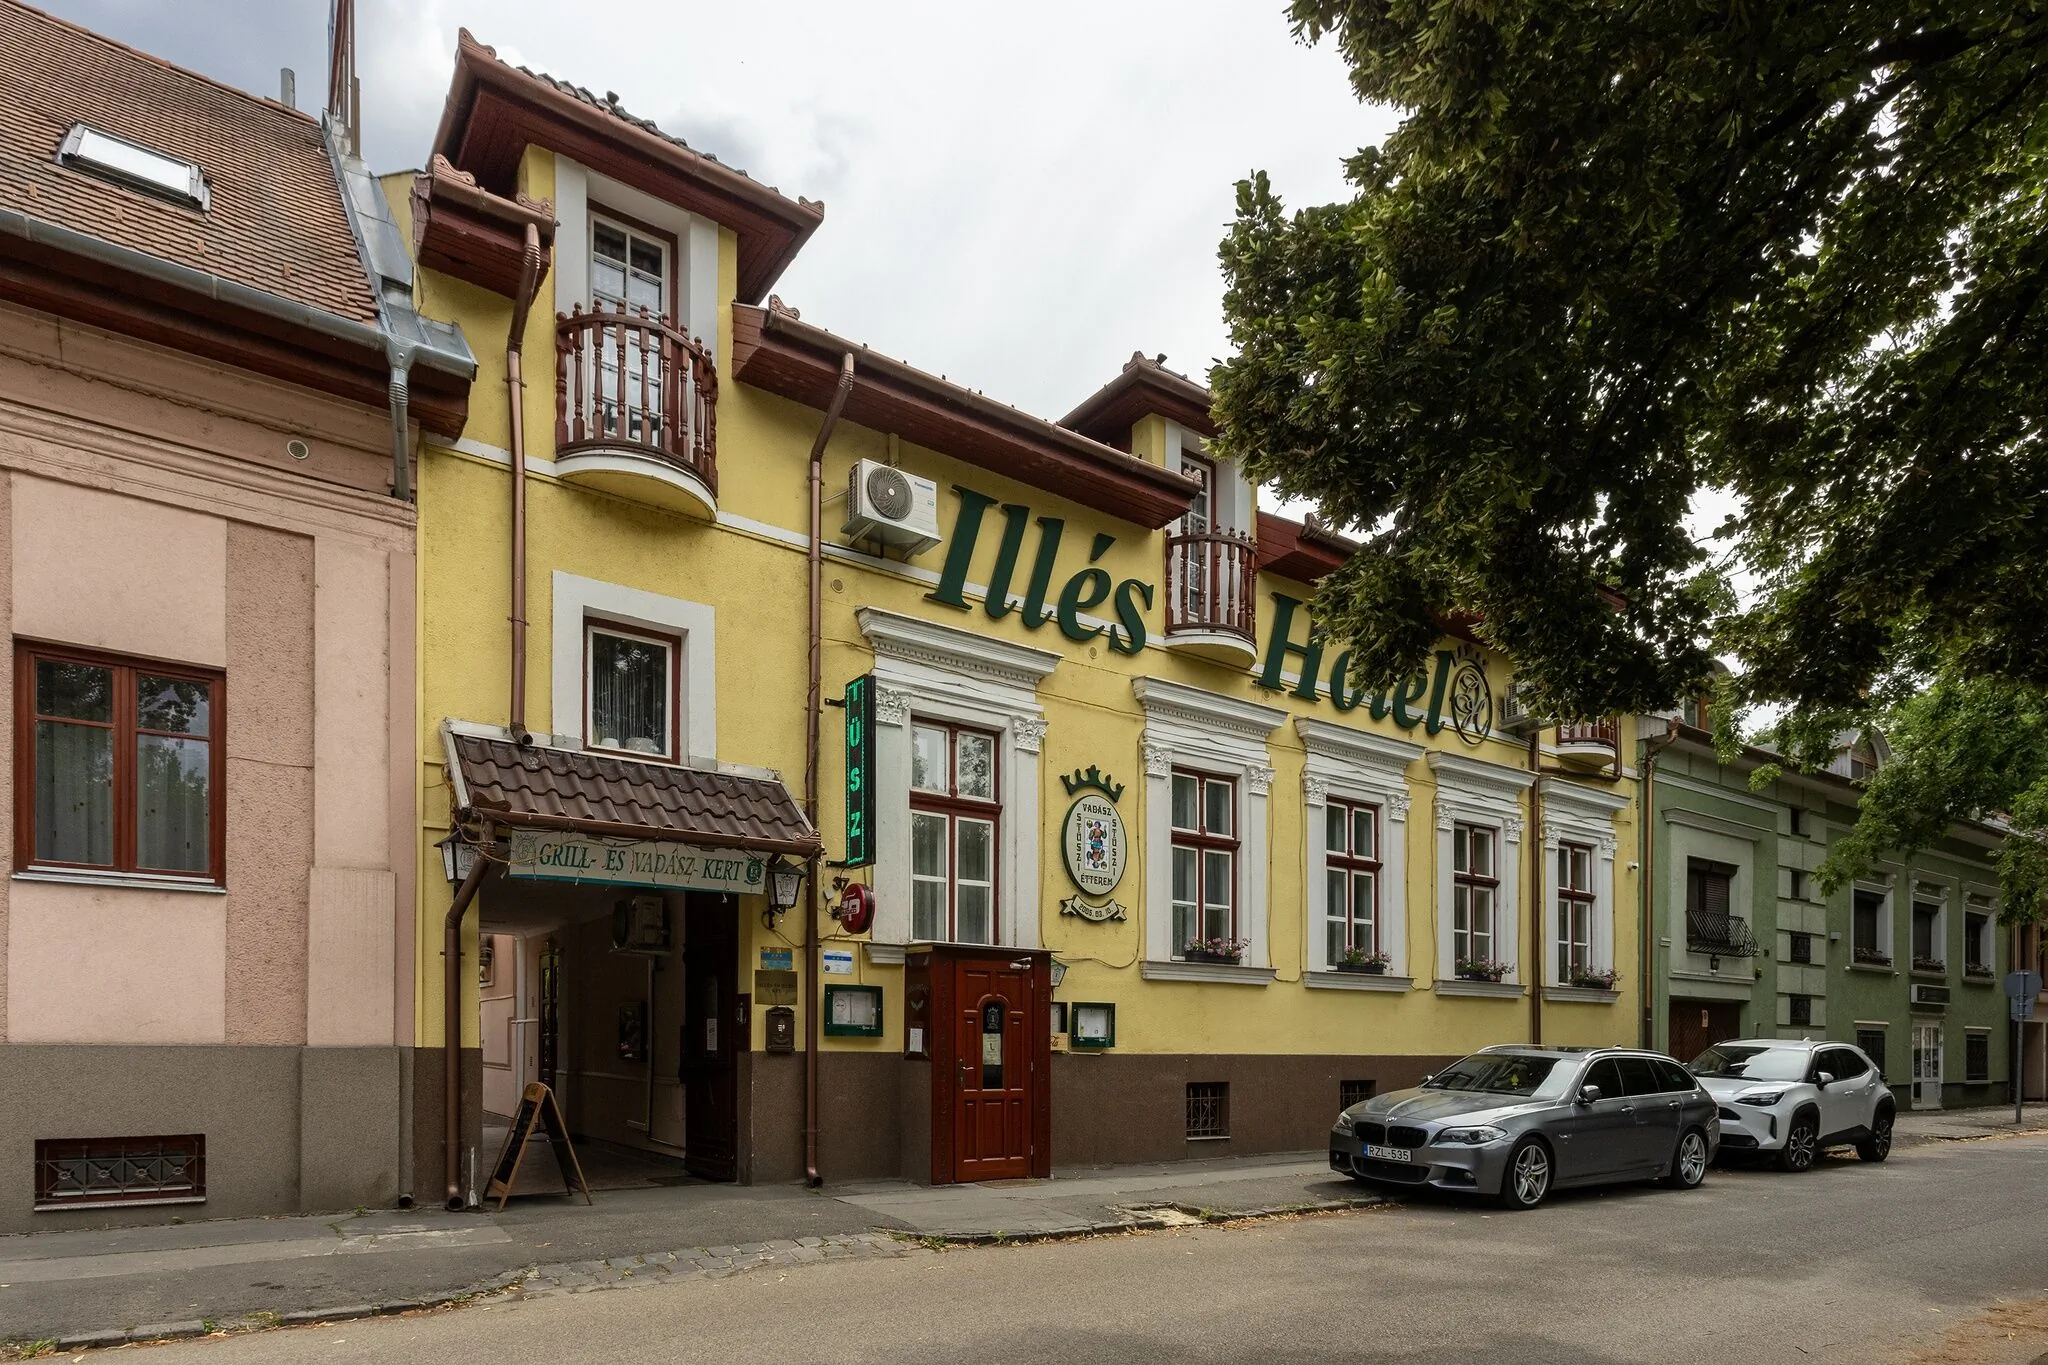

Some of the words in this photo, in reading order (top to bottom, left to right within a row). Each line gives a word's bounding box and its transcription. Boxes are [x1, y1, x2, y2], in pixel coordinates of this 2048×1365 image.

[923, 483, 1155, 655] Illés
[1082, 803, 1112, 816] VADÁSZ
[539, 842, 597, 870] GRILL-
[605, 842, 626, 872] ÉS
[703, 857, 744, 881] KERT
[1080, 872, 1113, 887] ÉTTEREM
[1368, 1145, 1409, 1160] RZL-535
